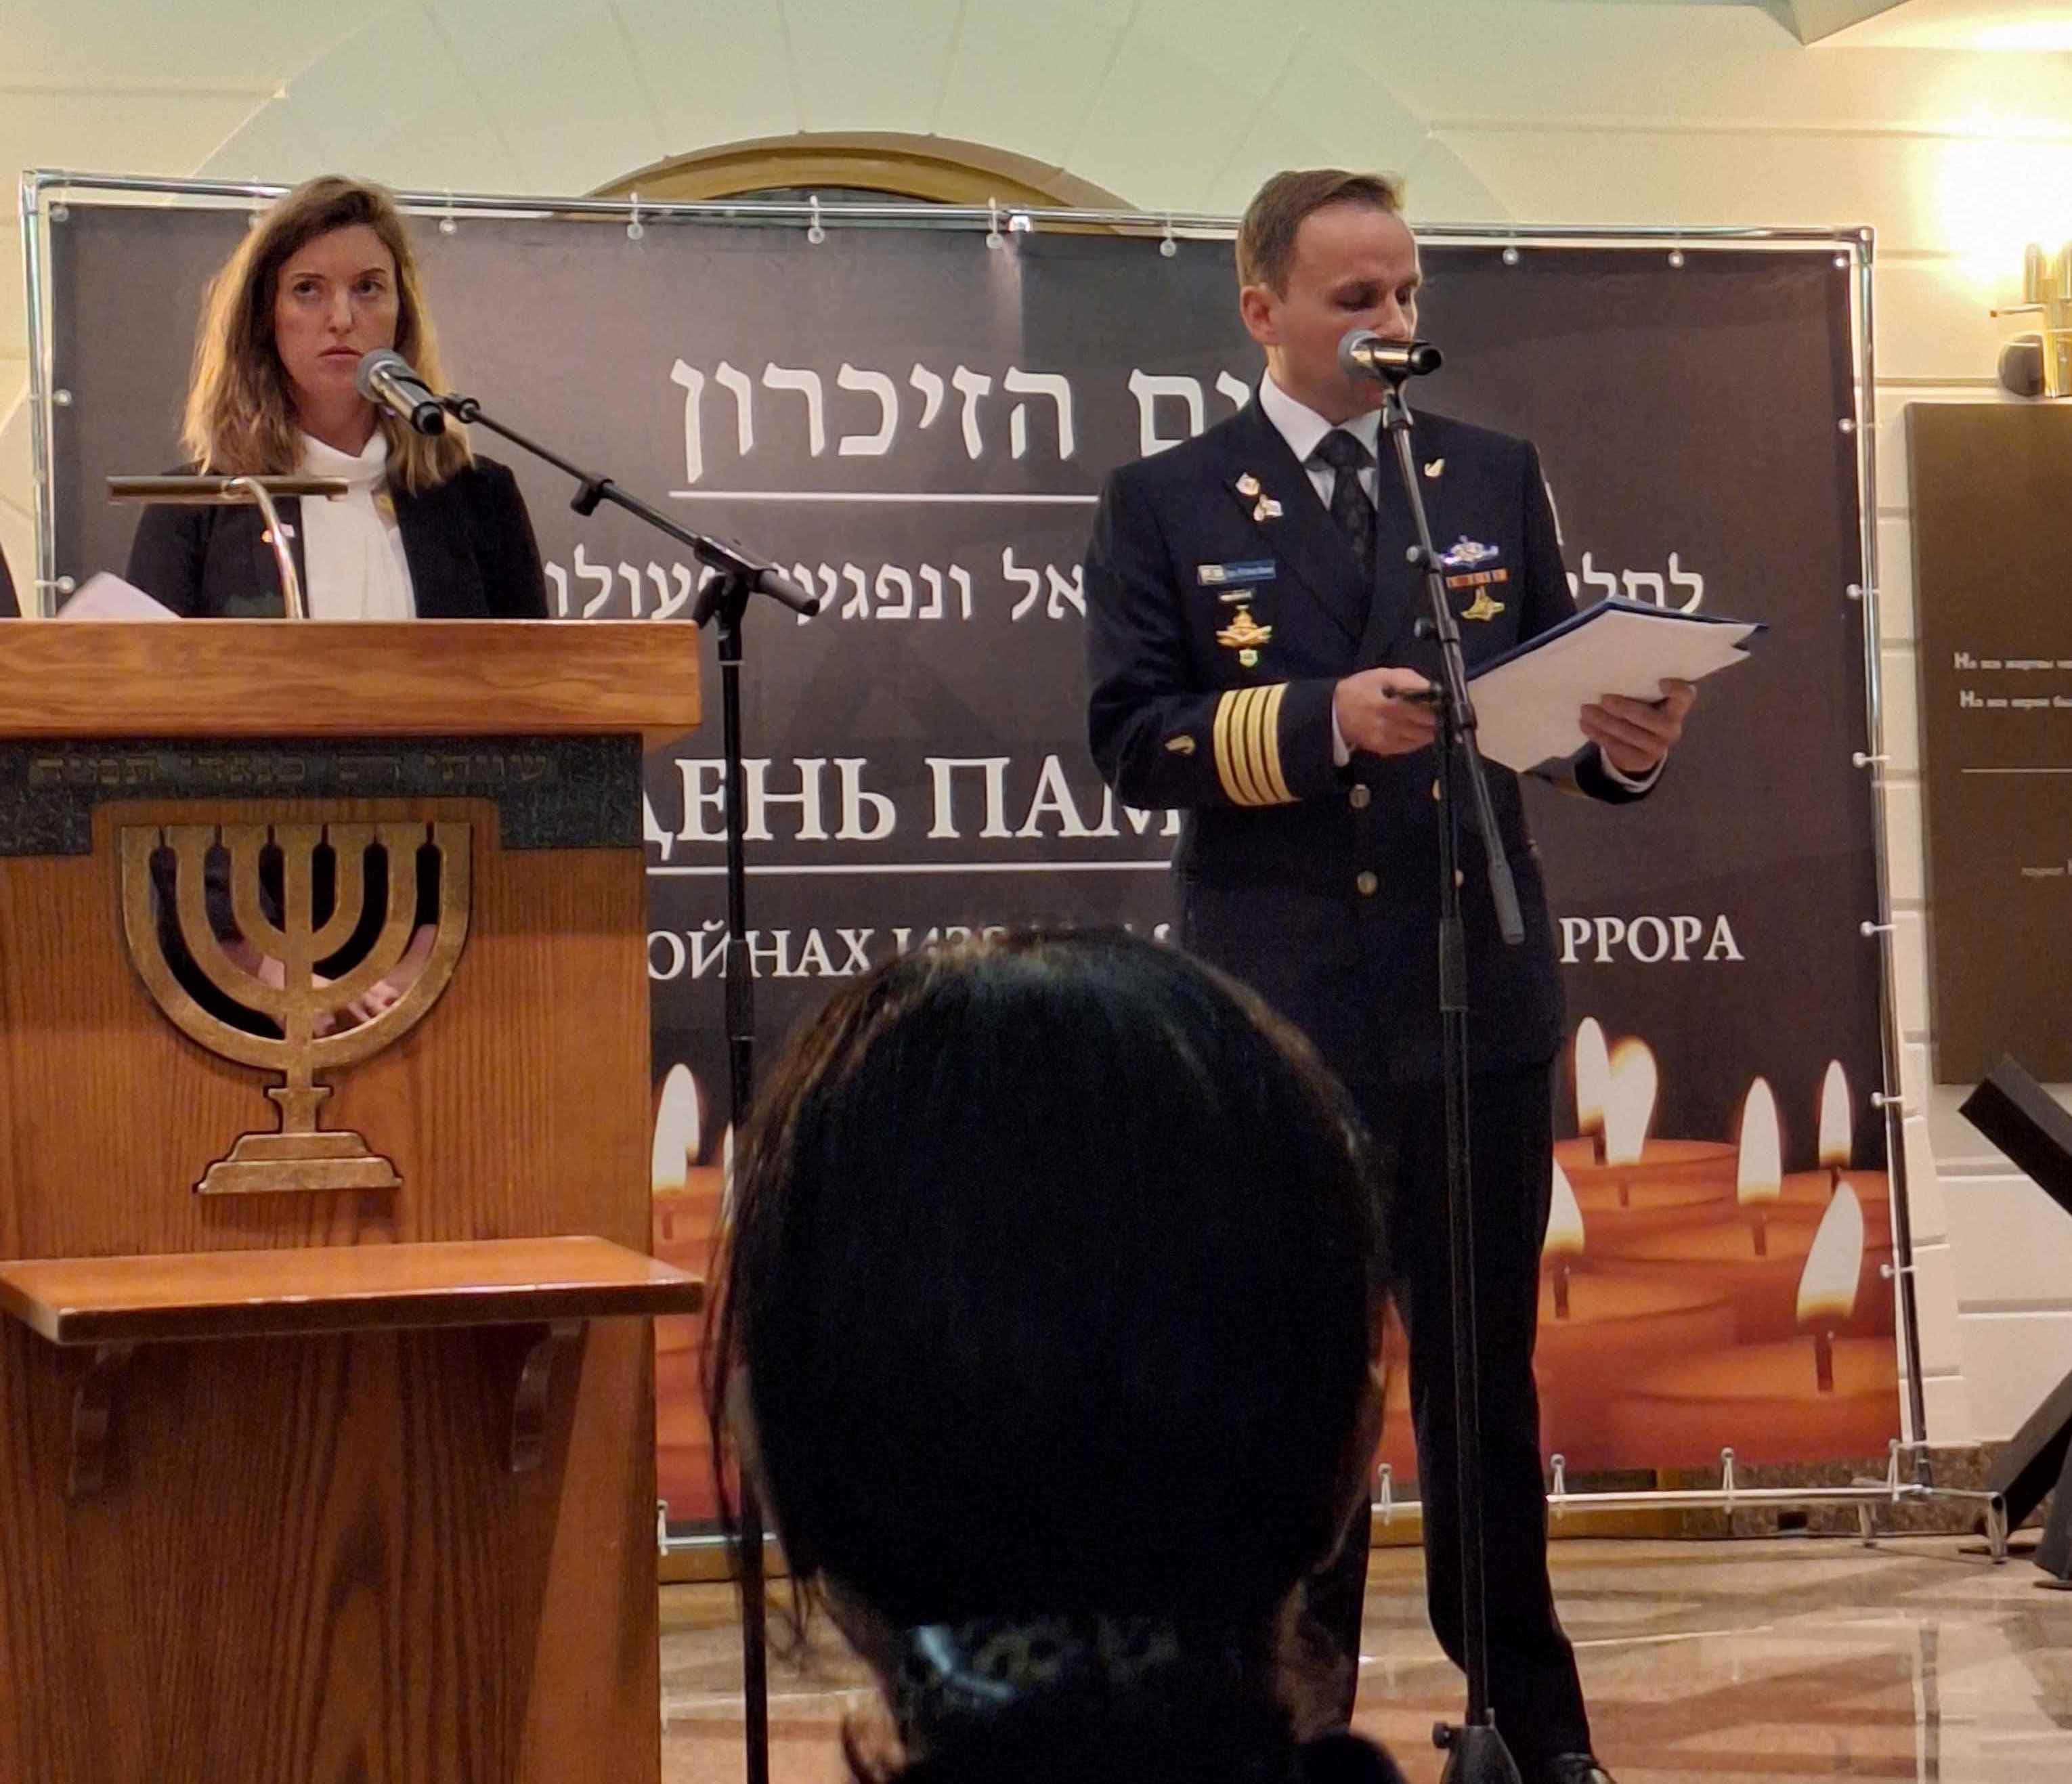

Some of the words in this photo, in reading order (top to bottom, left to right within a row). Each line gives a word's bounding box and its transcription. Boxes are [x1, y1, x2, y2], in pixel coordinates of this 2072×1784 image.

[669, 358, 1075, 484] הזיכרון
[1003, 546, 1086, 622] אל
[647, 919, 876, 980] ОЙНАХ
[1558, 914, 1746, 963] РРОРА
